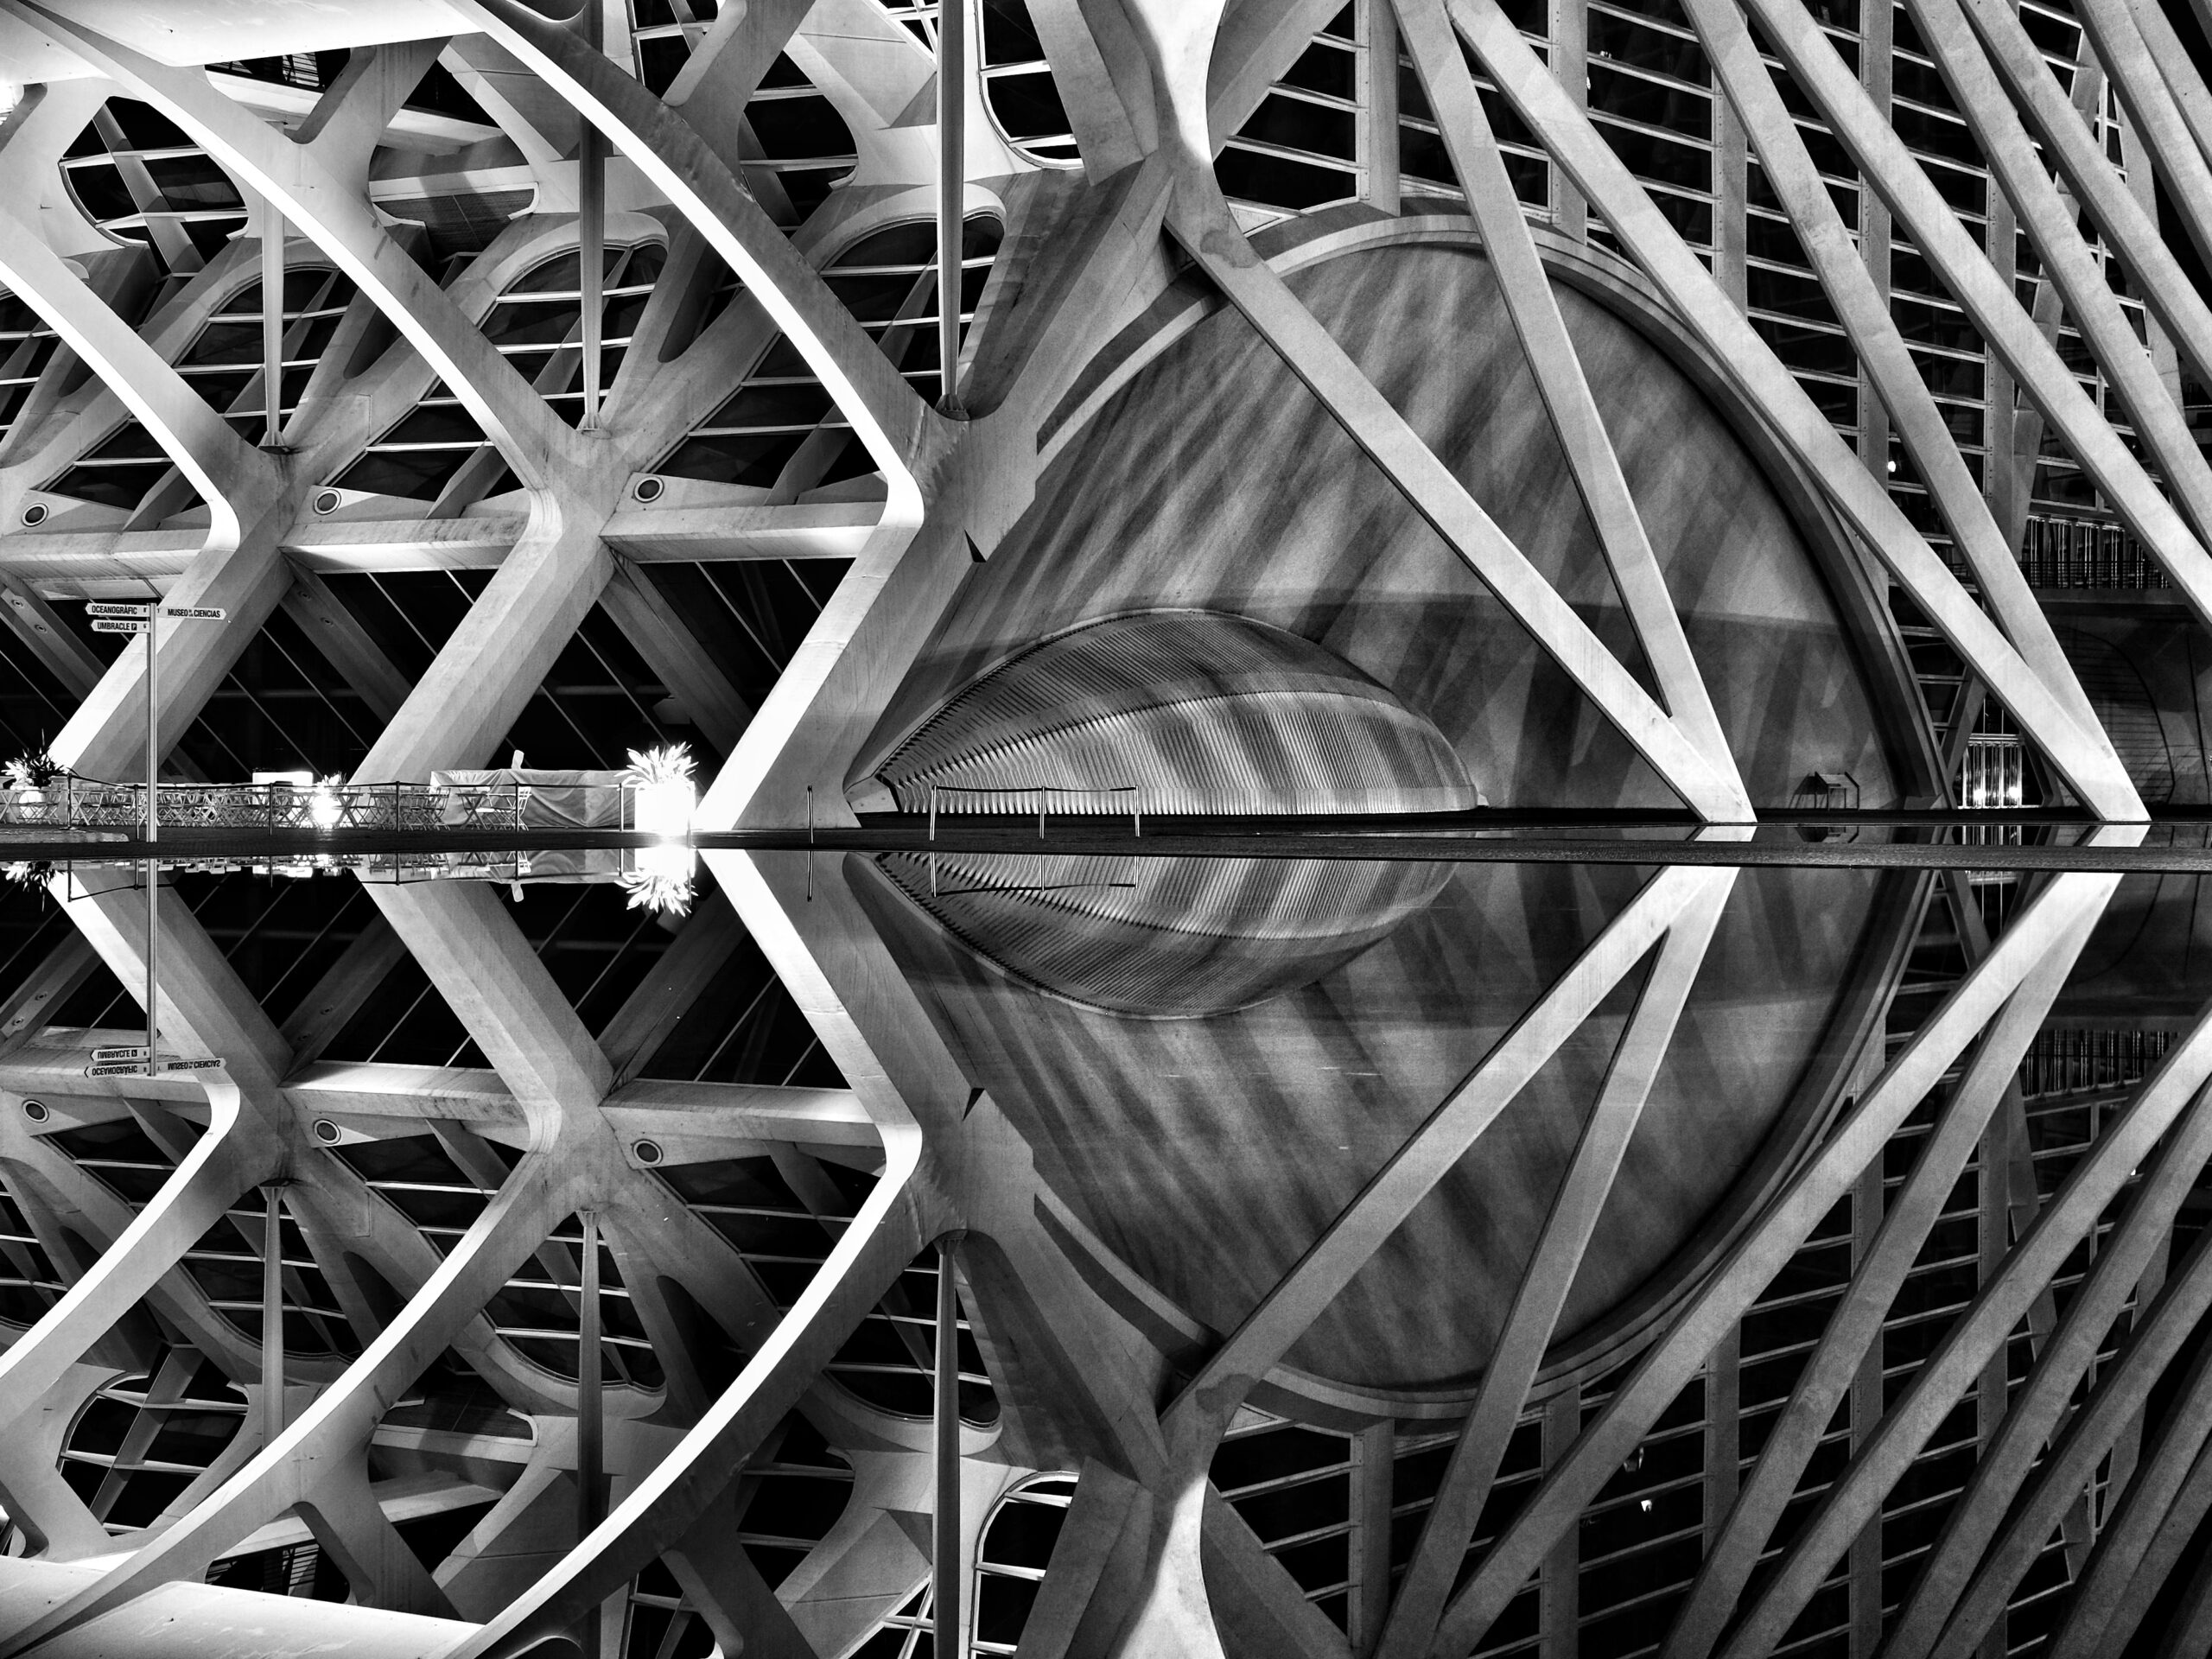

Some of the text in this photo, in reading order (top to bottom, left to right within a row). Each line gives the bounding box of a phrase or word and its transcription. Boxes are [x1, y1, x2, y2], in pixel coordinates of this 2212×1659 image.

[92, 604, 137, 614] OCEANOGRÀFIC
[194, 609, 220, 618] CIENCIAS
[97, 622, 130, 631] UMBRACLE
